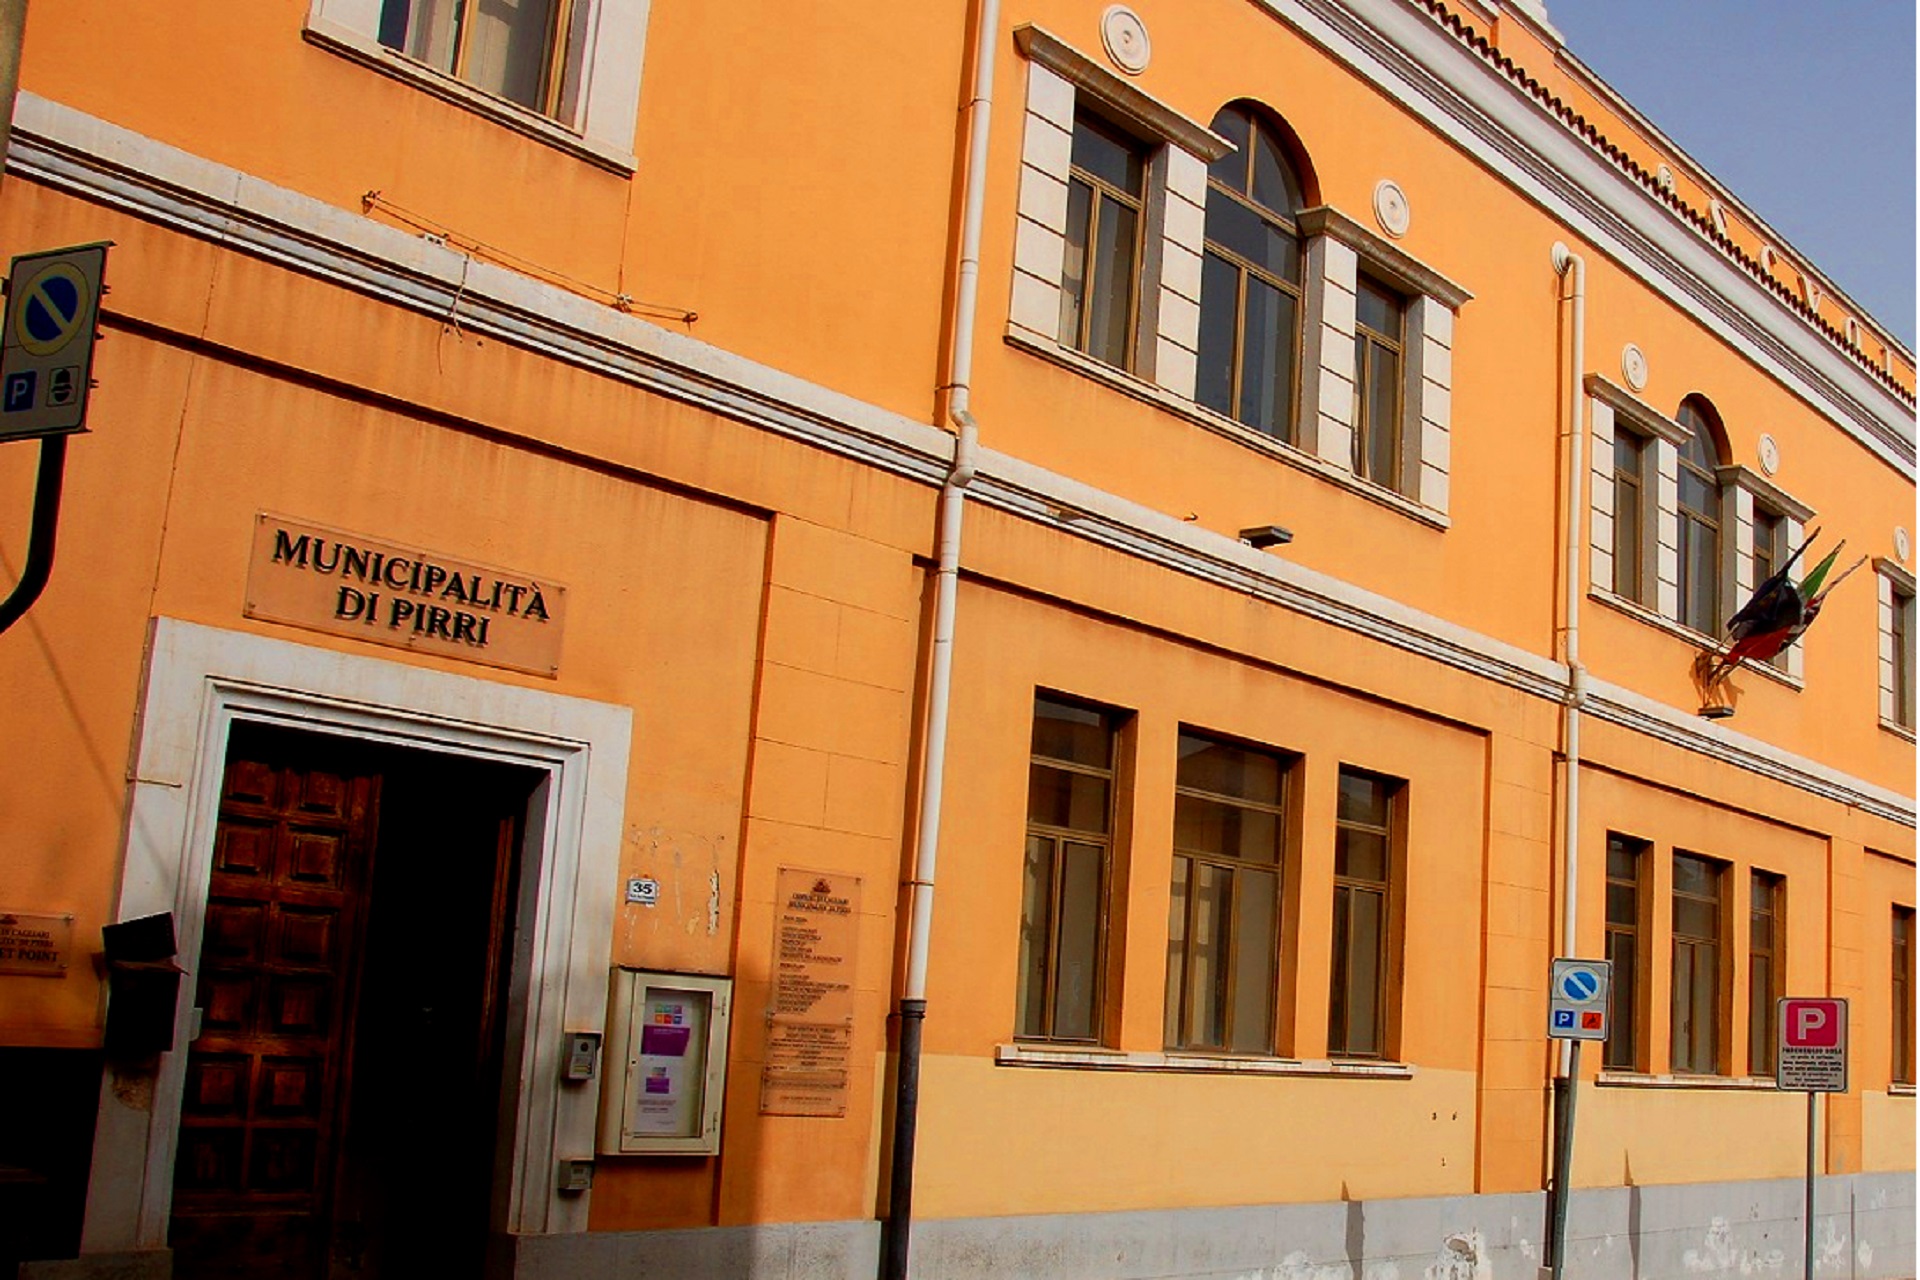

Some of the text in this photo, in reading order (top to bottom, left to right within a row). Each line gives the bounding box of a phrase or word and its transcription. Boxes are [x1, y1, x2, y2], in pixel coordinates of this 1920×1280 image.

[11, 379, 28, 405] P
[273, 529, 550, 622] MUNICIPALITÀ
[335, 586, 490, 646] DI PIRRI
[633, 882, 652, 895] 35
[18, 949, 60, 962] POINT
[1558, 1012, 1570, 1025] P
[1798, 1007, 1826, 1040] P
